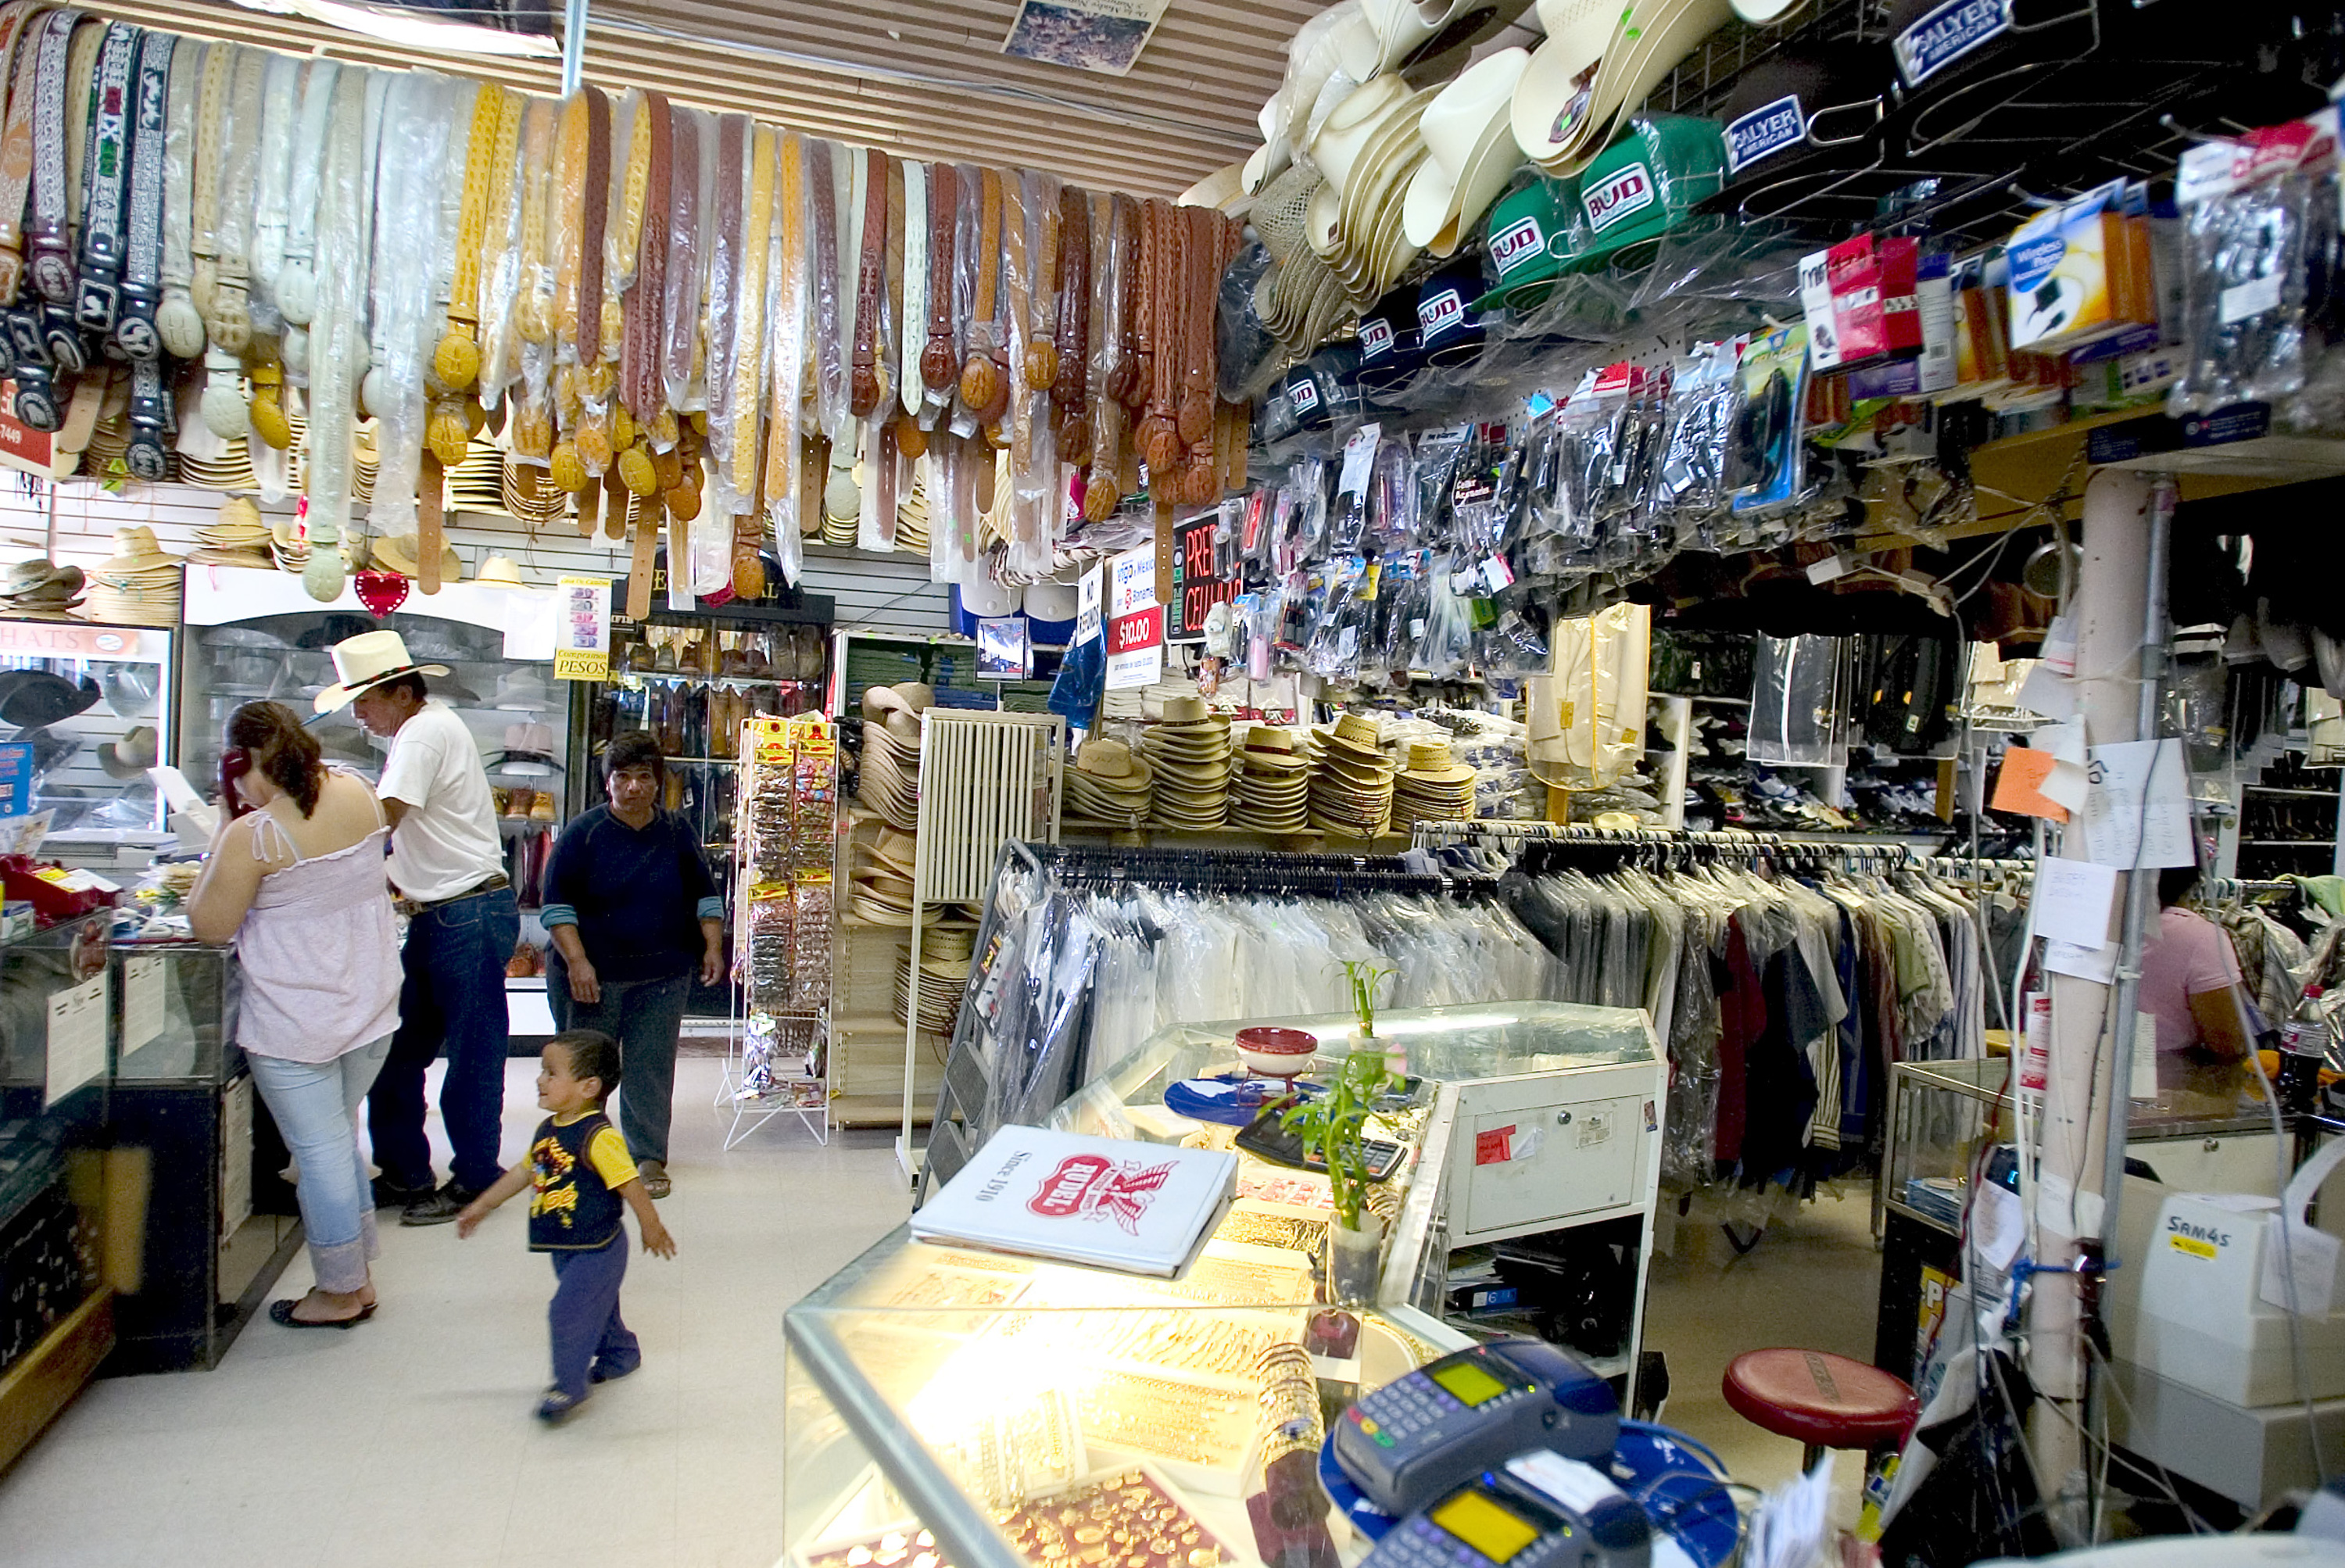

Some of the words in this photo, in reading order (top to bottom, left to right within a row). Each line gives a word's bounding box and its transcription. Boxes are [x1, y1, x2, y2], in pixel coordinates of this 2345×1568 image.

[1928, 13, 1997, 62] AMERICAN
[1735, 109, 1797, 149] SALYER
[1742, 126, 1793, 156] AMERICAN
[1589, 176, 1644, 218] BUD
[1493, 227, 1535, 263] BUD
[2017, 239, 2063, 264] Wireless
[1363, 325, 1387, 347] UD
[1294, 386, 1312, 405] UD
[1137, 556, 1155, 574] Méxic
[1133, 586, 1155, 603] Baname
[0, 627, 78, 650] HATS
[1119, 617, 1150, 650] $10.00
[558, 650, 607, 659] Compramos
[559, 660, 607, 675] PESOS
[997, 1151, 1033, 1176] Since
[975, 1178, 1008, 1202] 1910
